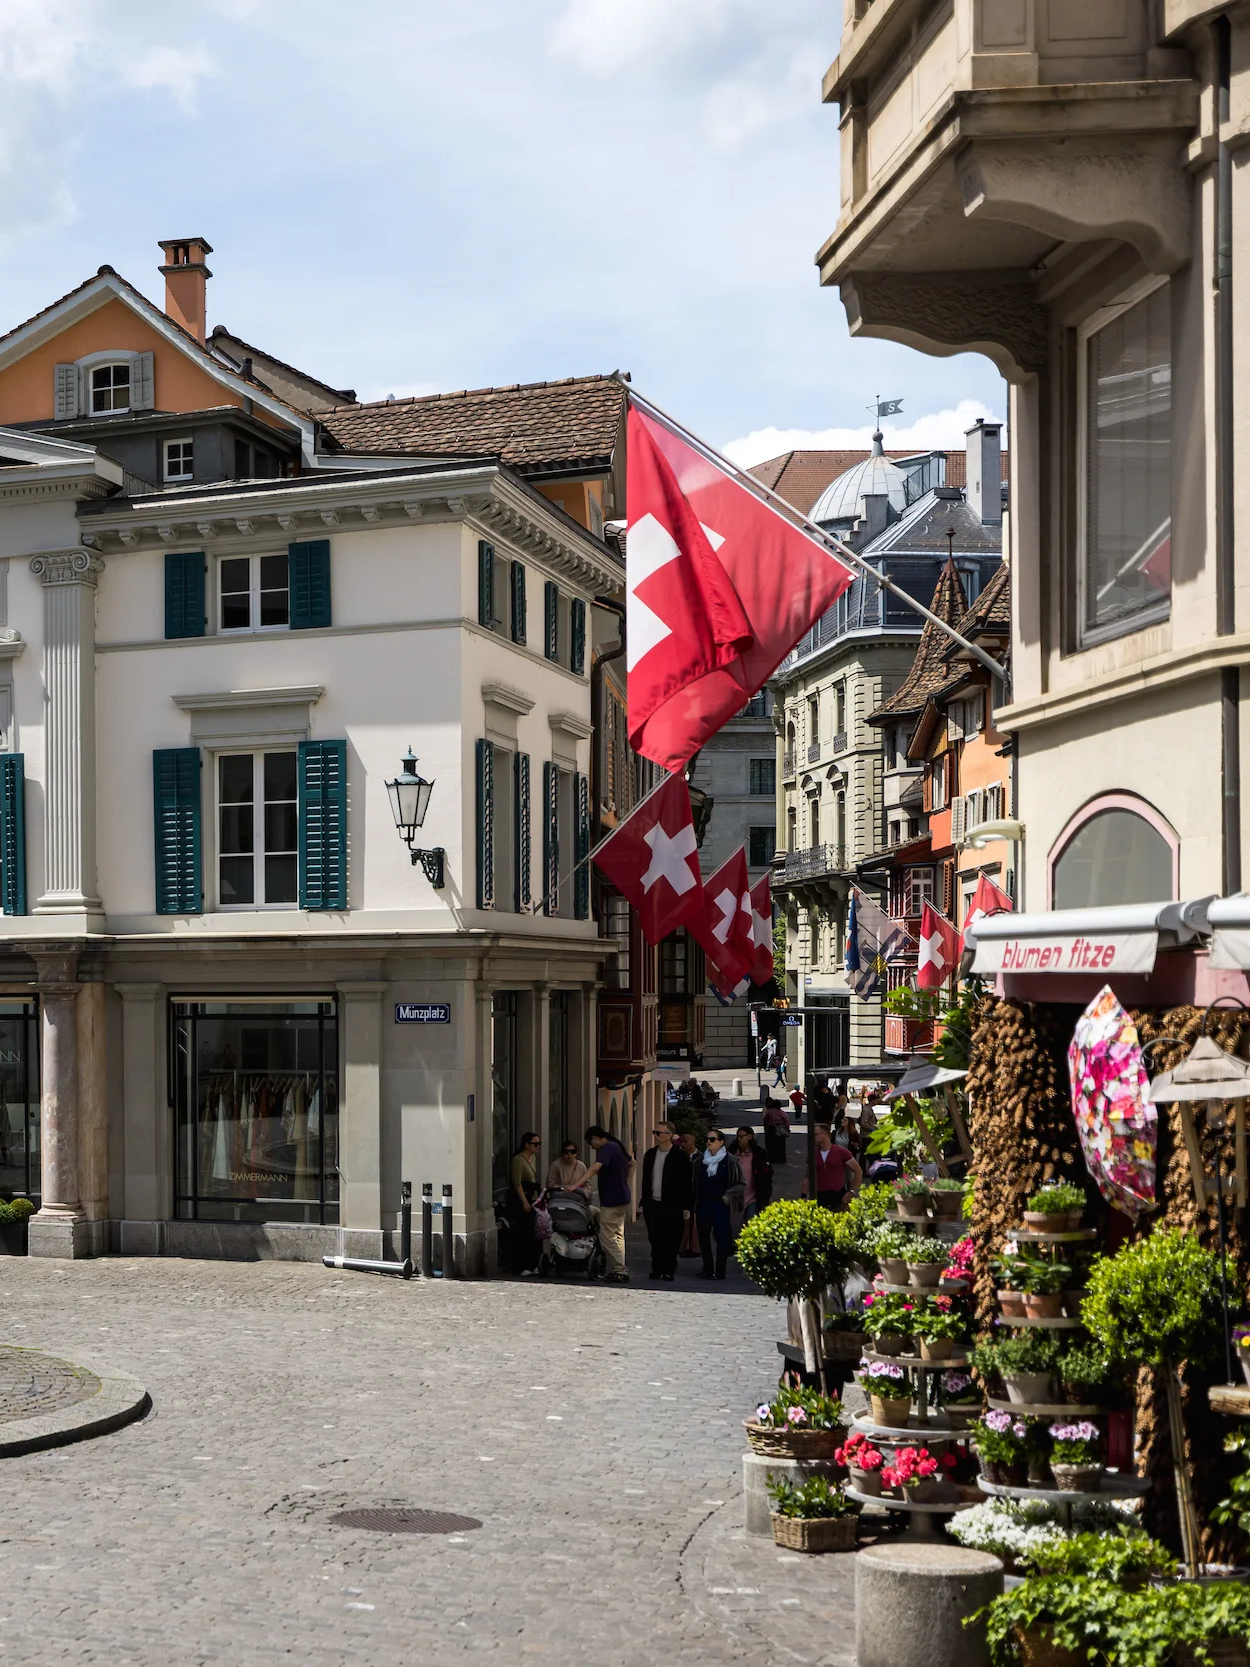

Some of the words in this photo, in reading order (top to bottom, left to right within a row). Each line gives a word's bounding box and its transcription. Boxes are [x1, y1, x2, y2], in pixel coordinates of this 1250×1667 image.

[1001, 941, 1063, 969] blumen
[1068, 938, 1116, 968] fitze
[399, 1006, 445, 1022] Münzplatz
[229, 1171, 288, 1182] ZIMMERMANN
